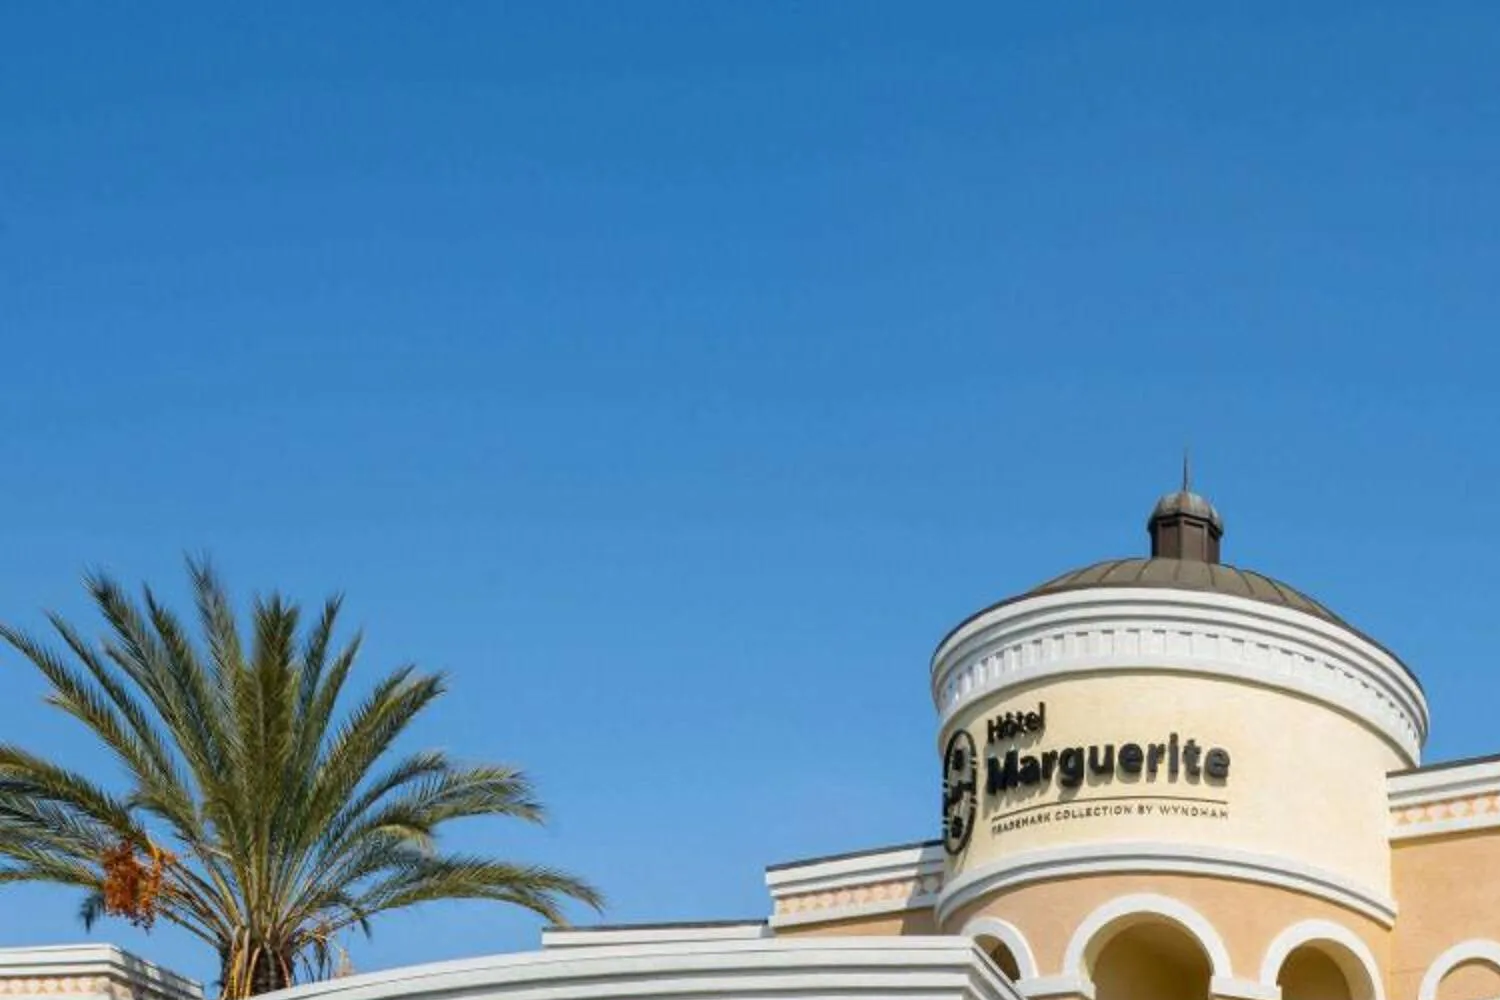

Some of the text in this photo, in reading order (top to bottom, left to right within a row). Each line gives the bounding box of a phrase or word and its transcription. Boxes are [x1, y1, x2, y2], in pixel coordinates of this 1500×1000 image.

[987, 732, 1230, 795] Marguerite
[992, 804, 1229, 833] TRADEMARK COLLECTION BY WYNDHAM
